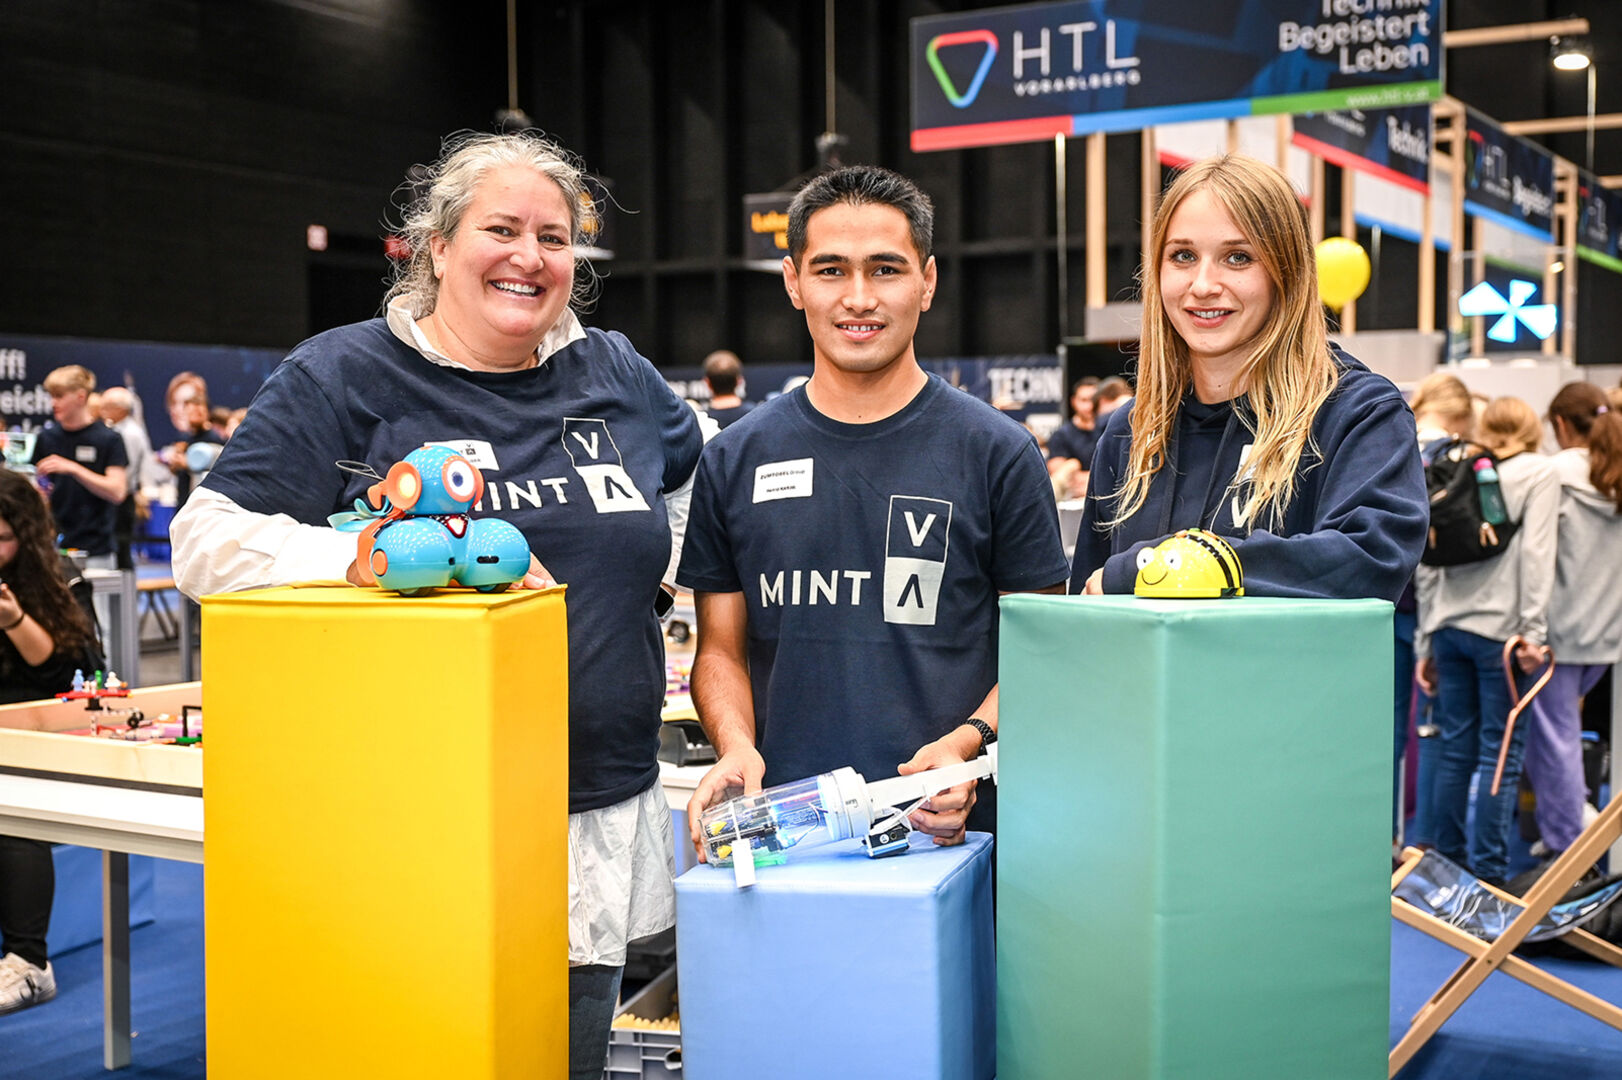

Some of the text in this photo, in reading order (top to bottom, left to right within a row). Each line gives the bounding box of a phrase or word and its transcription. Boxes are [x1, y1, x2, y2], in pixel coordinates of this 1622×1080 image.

[1013, 19, 1140, 79] HTL
[1279, 9, 1431, 54] Begeistert
[1339, 42, 1429, 74] Leben
[1013, 69, 1141, 97] VORARLBERG
[571, 431, 599, 460] V
[474, 477, 568, 512] INT
[903, 511, 937, 548] V
[760, 570, 872, 608] MINT
